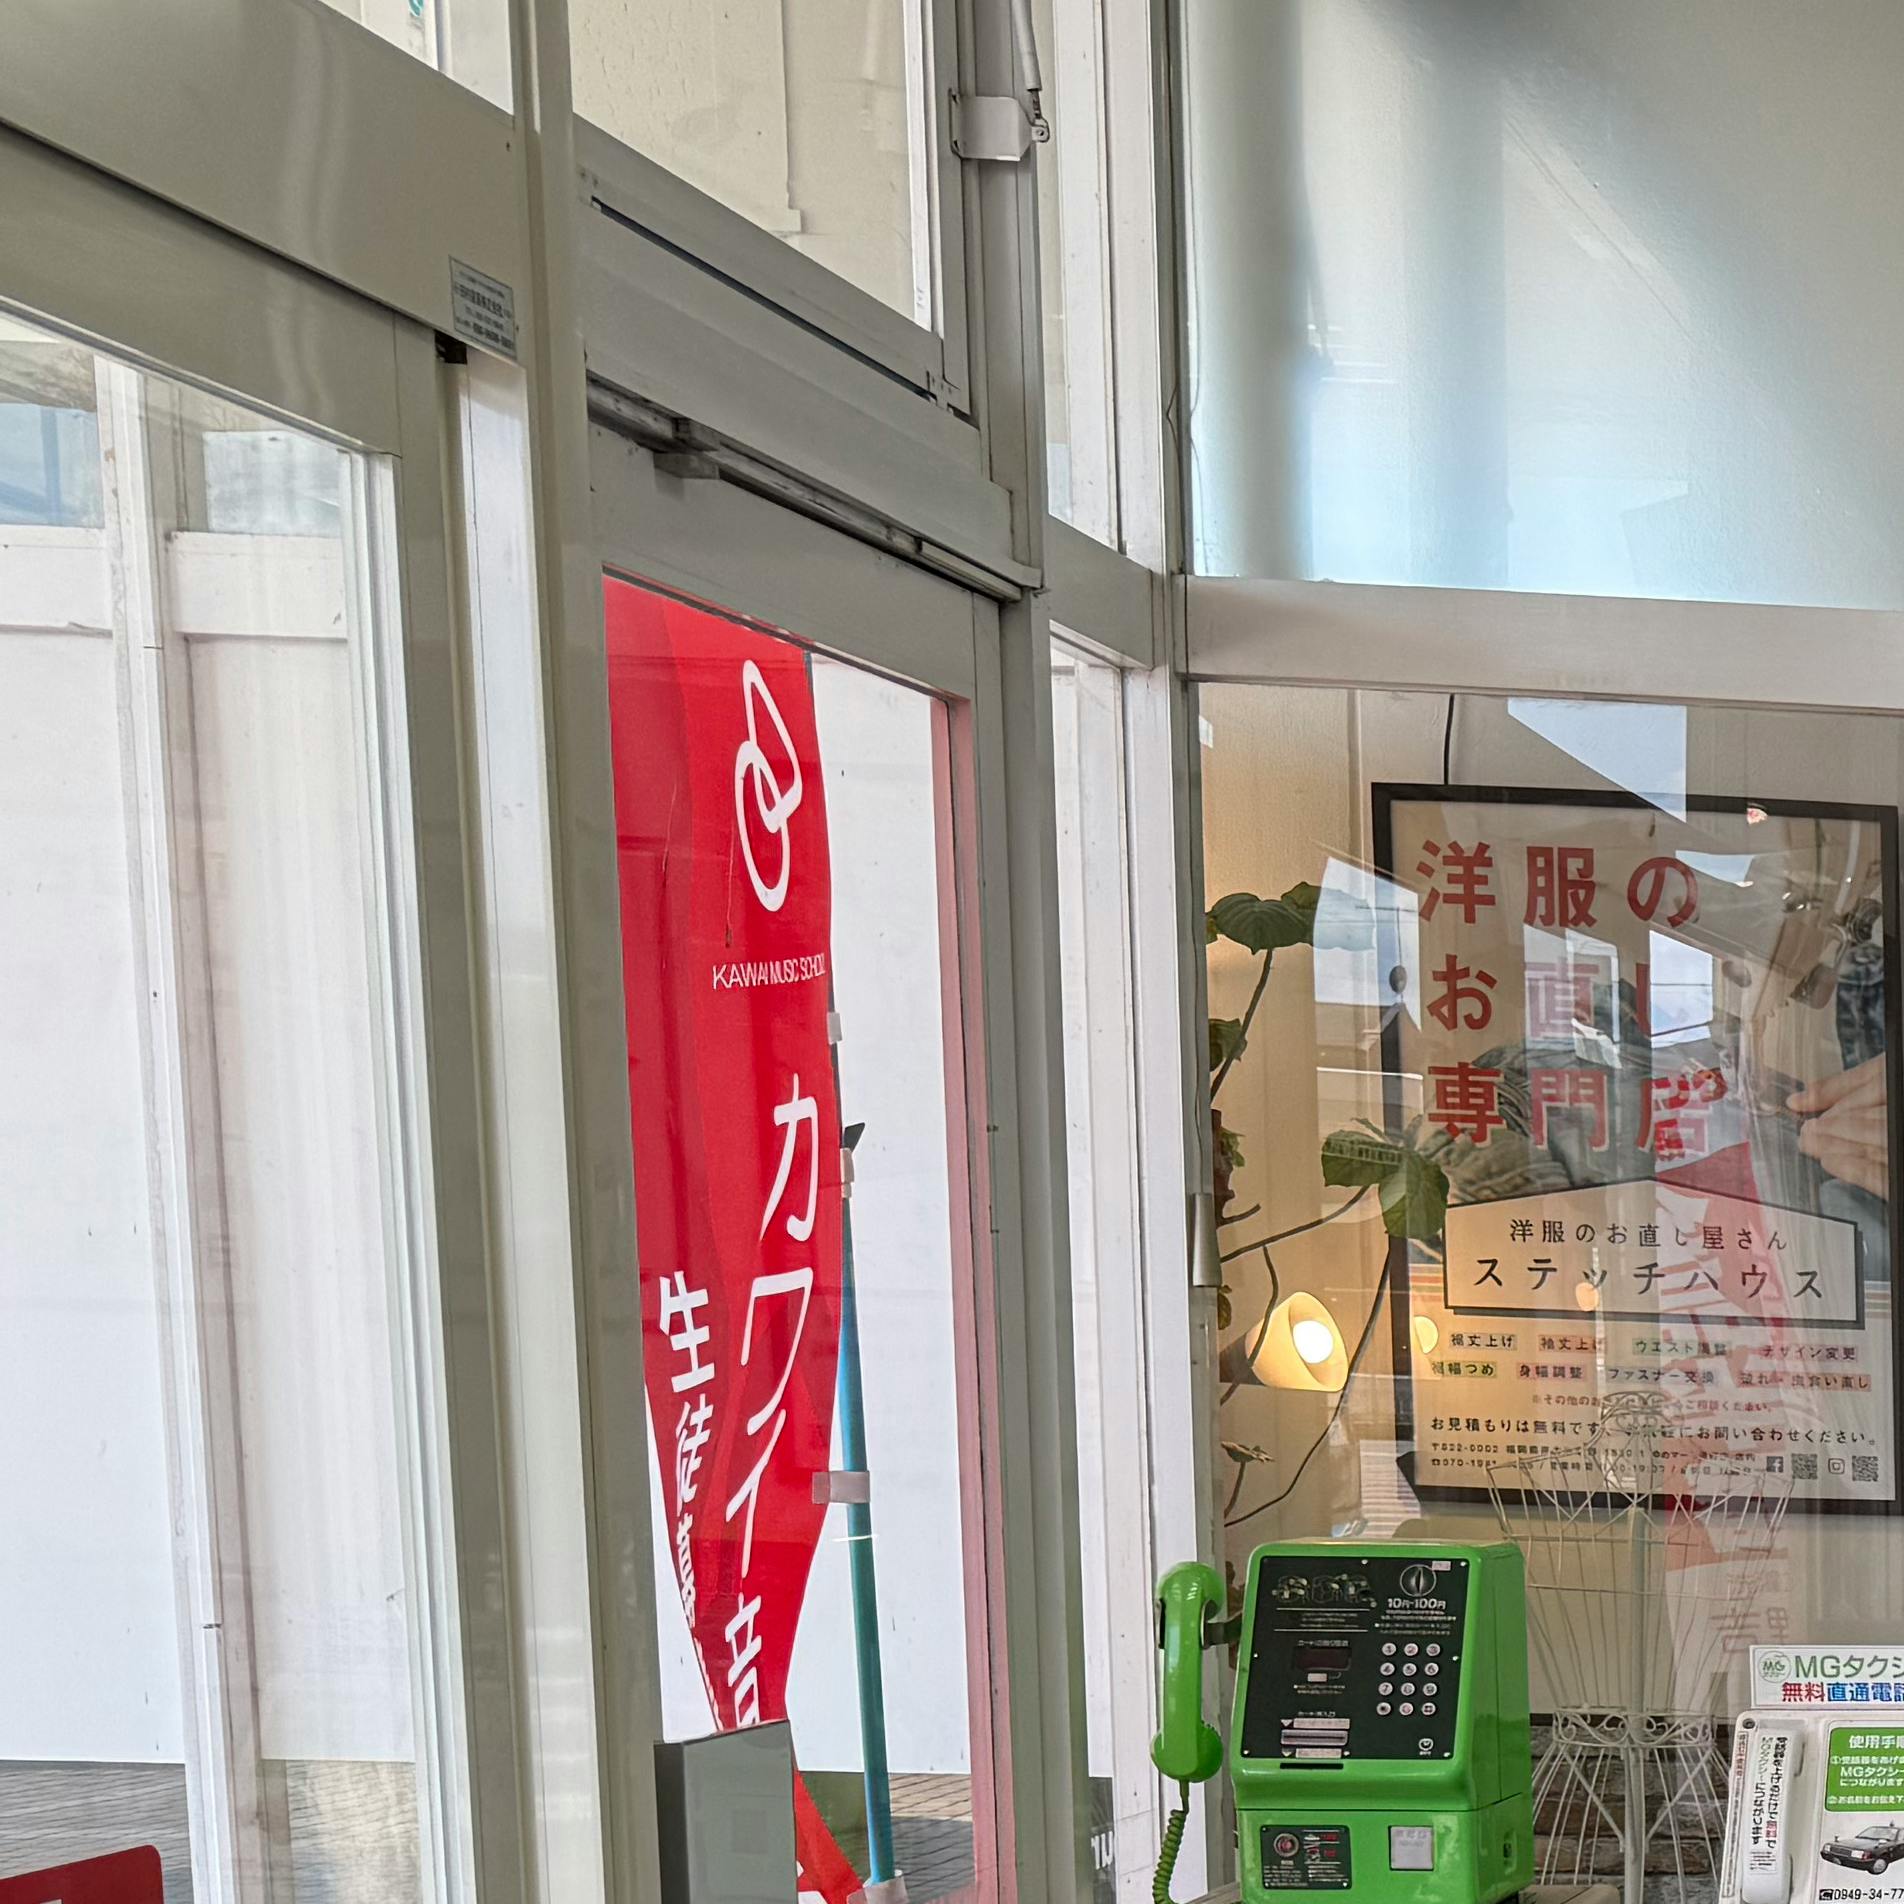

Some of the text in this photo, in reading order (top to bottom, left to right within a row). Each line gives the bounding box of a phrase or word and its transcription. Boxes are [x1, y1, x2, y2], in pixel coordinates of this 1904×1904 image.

[1416, 840, 1699, 928] 洋服の
[1510, 1218, 1788, 1252] 洋服のお直し屋さん
[1474, 1257, 1823, 1299] ステッチハウス
